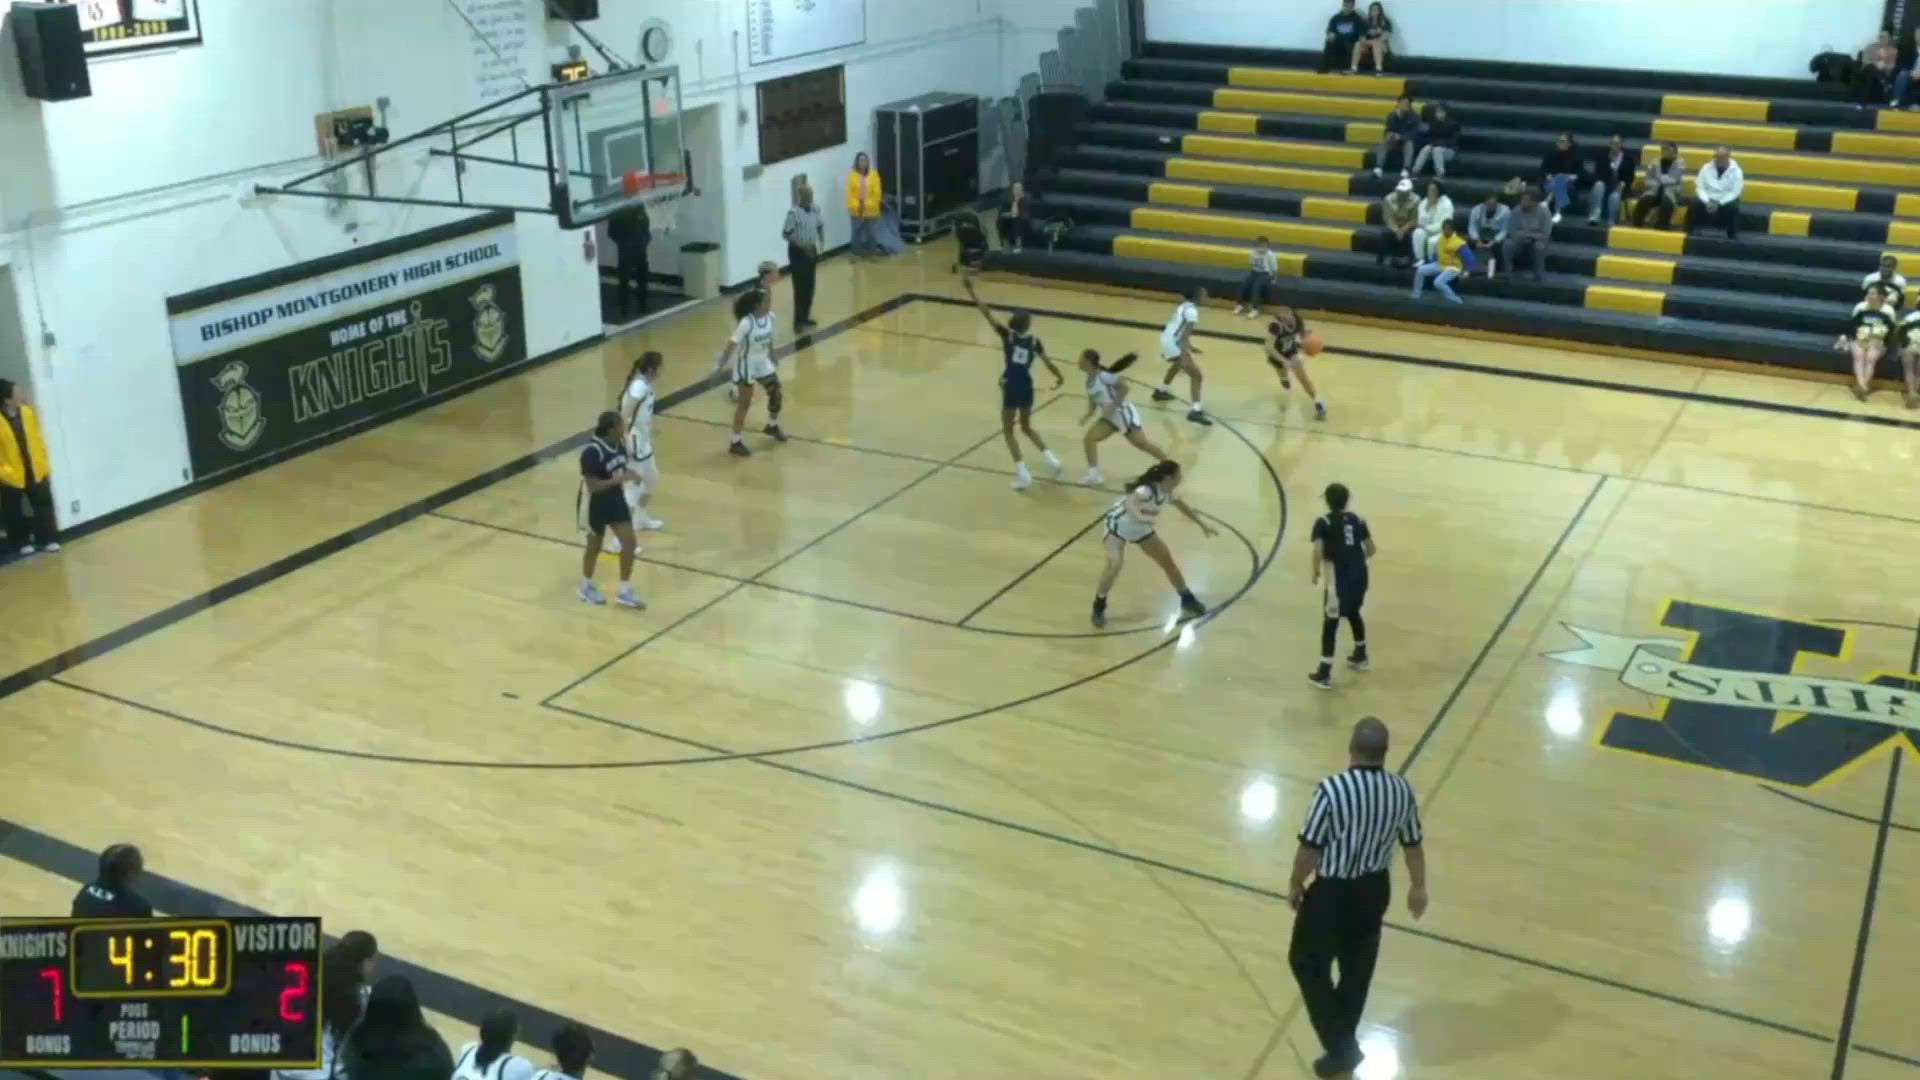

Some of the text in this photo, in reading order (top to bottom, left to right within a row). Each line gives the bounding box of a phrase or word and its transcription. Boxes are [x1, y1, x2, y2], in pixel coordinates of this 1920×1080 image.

[200, 243, 503, 342] BISHOP MONTGOMERY HIGH SCHOOL
[330, 309, 408, 347] HOME OF THE
[287, 303, 453, 424] KNIGHTS
